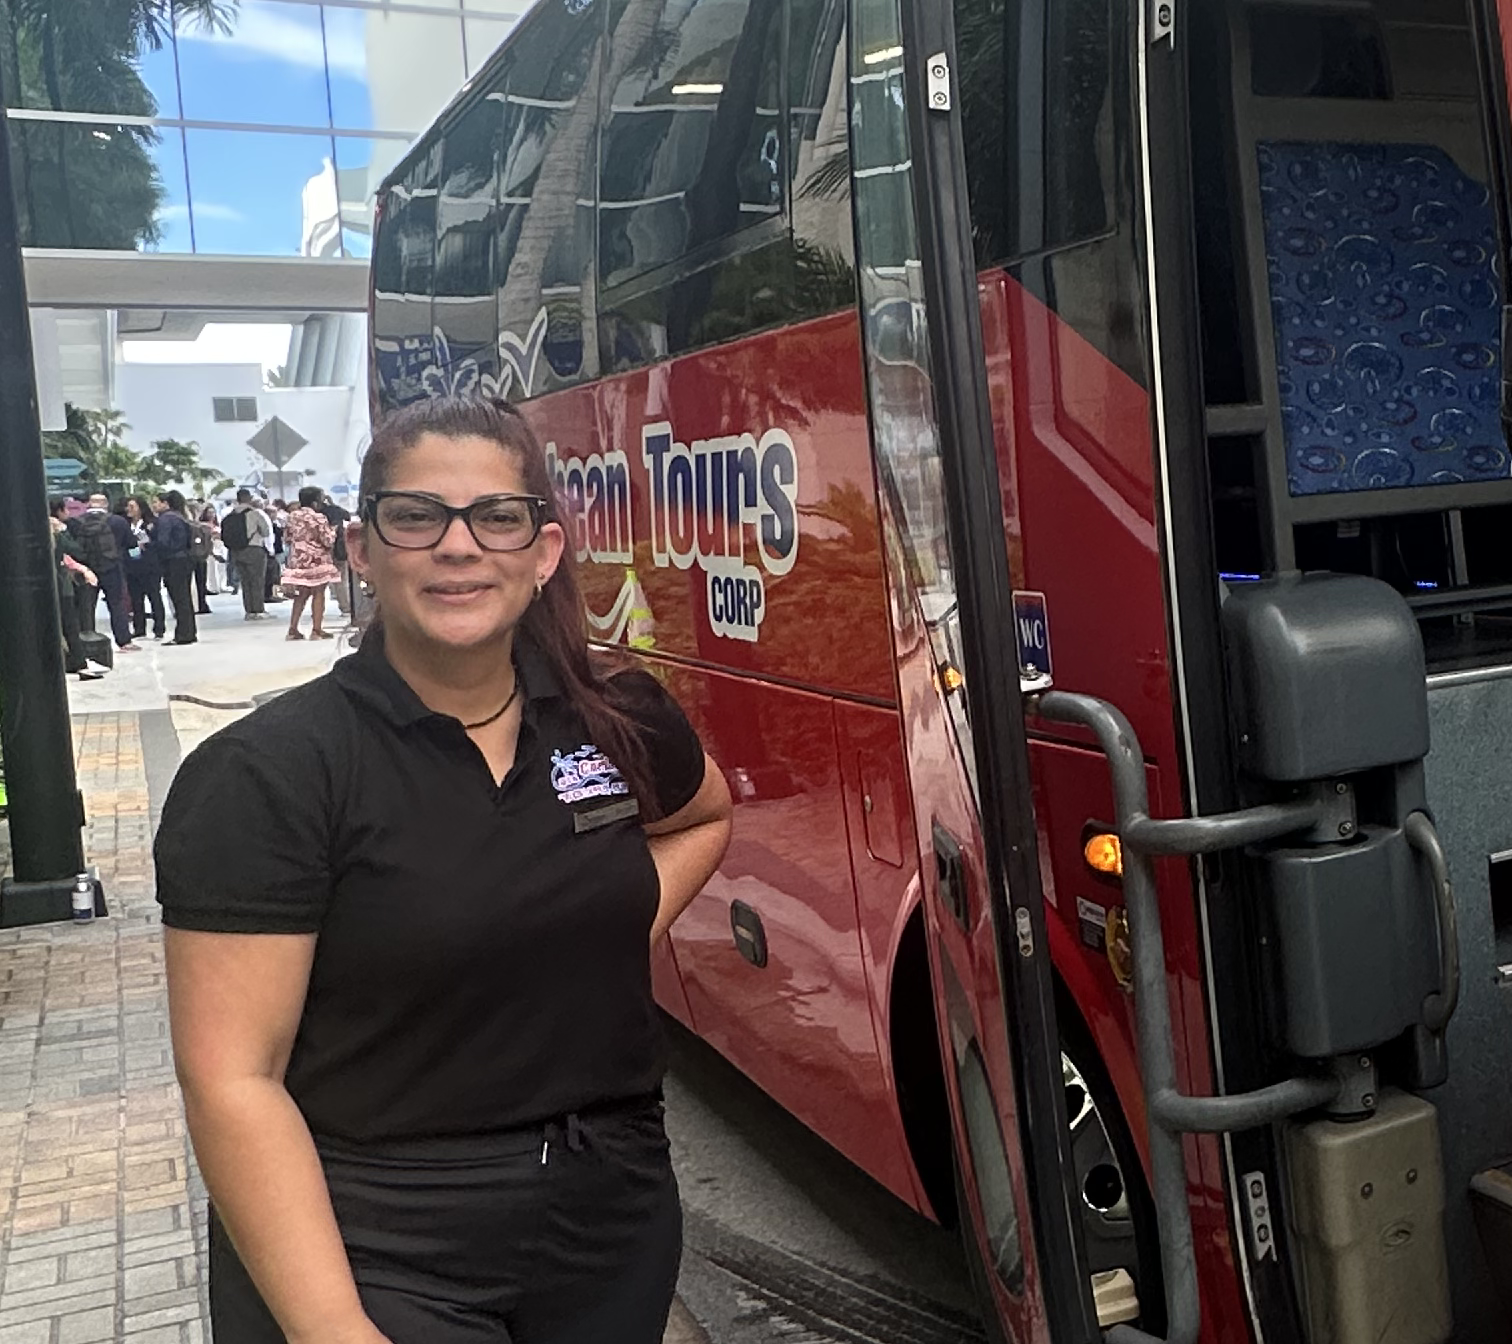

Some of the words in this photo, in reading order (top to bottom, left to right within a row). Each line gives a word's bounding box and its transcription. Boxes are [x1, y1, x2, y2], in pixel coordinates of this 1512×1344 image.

[644, 425, 797, 572] Tours
[710, 574, 764, 630] CORP
[1019, 618, 1044, 649] WC
